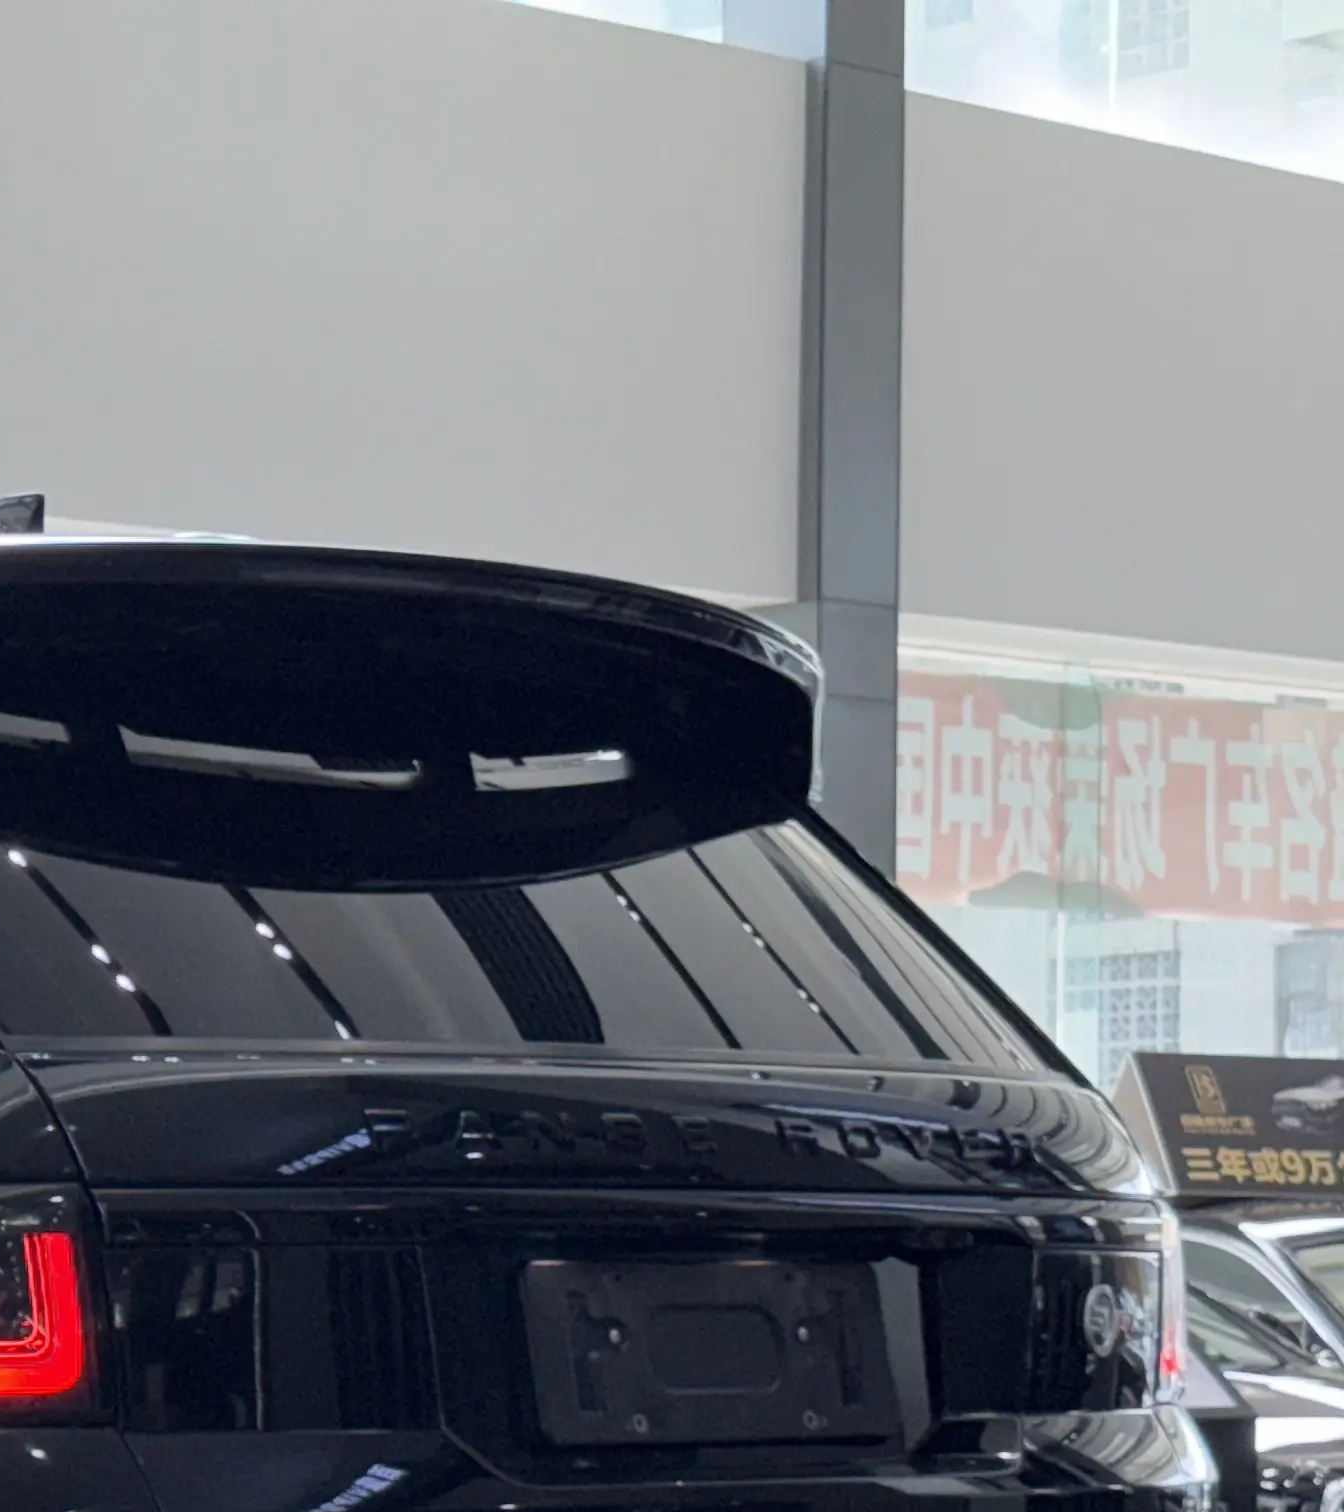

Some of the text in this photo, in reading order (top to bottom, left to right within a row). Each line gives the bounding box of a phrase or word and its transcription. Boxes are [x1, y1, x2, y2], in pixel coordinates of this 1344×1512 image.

[363, 1107, 1036, 1168] RANGE ROVER
[1180, 1146, 1344, 1185] 三年或9万
